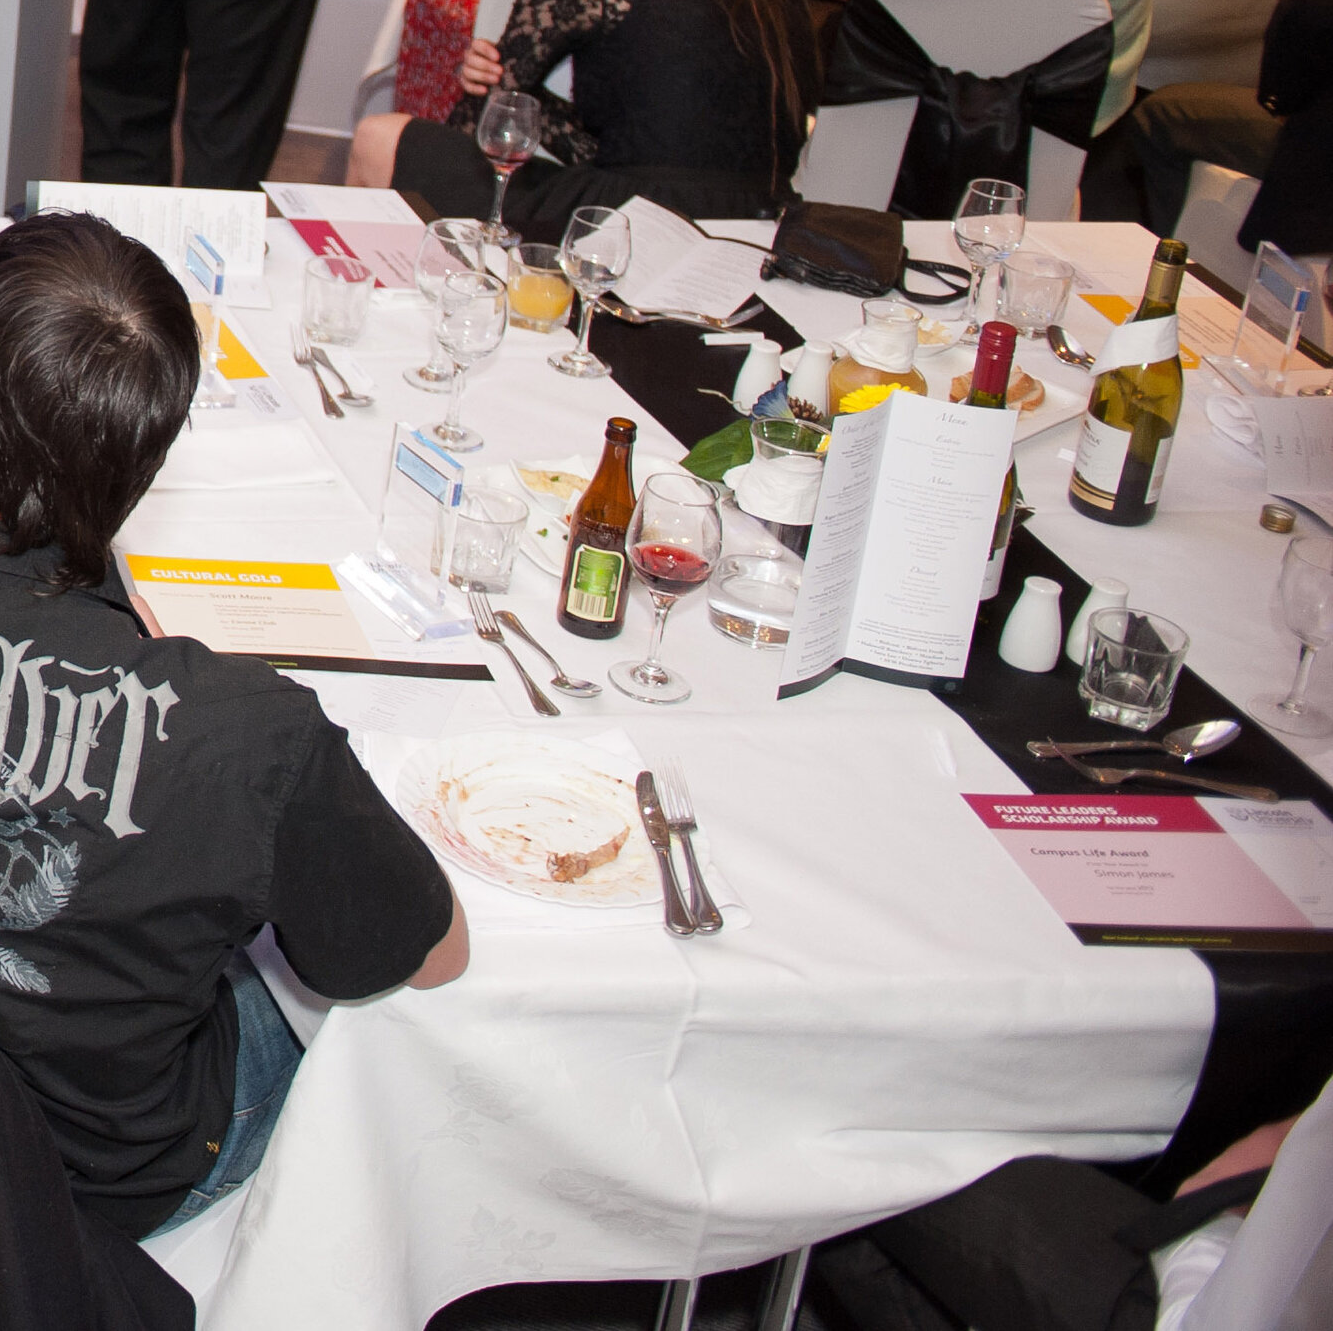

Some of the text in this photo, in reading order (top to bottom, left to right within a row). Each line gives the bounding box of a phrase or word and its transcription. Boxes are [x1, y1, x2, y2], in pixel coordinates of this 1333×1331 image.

[150, 568, 283, 584] CULTURAL GOLD
[992, 805, 1118, 816] FUTURE LEADERS
[1001, 814, 1160, 826] SCHOLARSHIP AWARD
[1030, 847, 1150, 858] Campus Life Award
